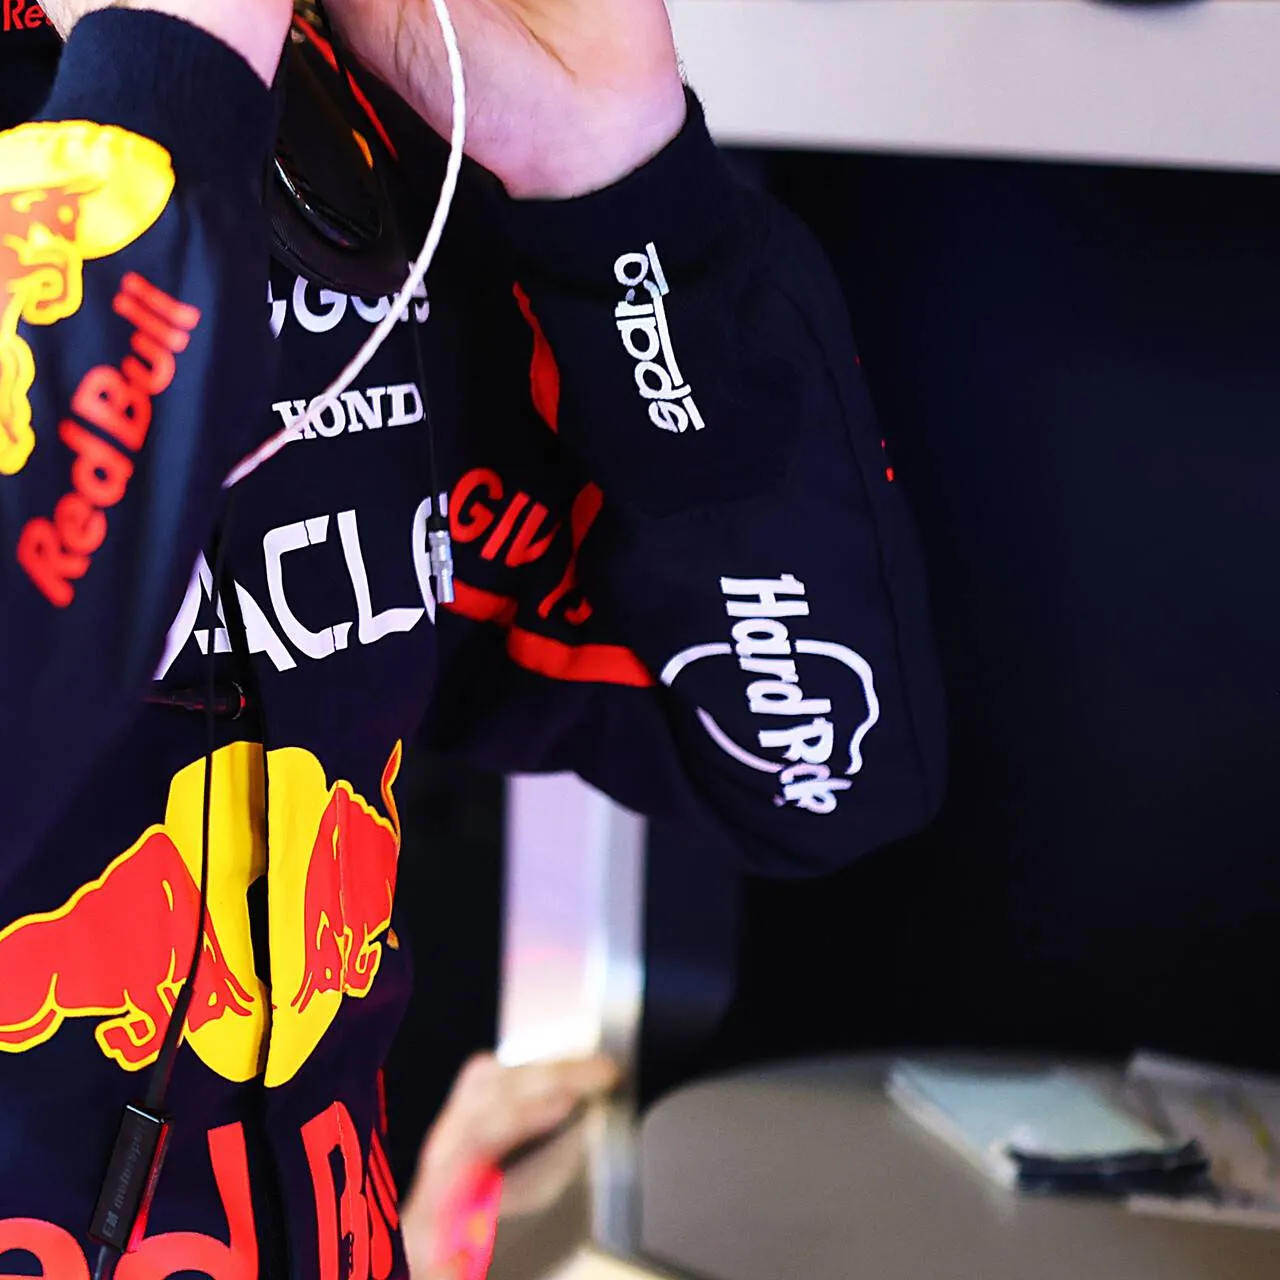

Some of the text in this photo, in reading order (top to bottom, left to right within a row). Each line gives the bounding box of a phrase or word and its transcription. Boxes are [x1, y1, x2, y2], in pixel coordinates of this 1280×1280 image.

[16, 270, 202, 608] Red Bull
[272, 382, 427, 442] HOND
[720, 573, 832, 715] Hard
